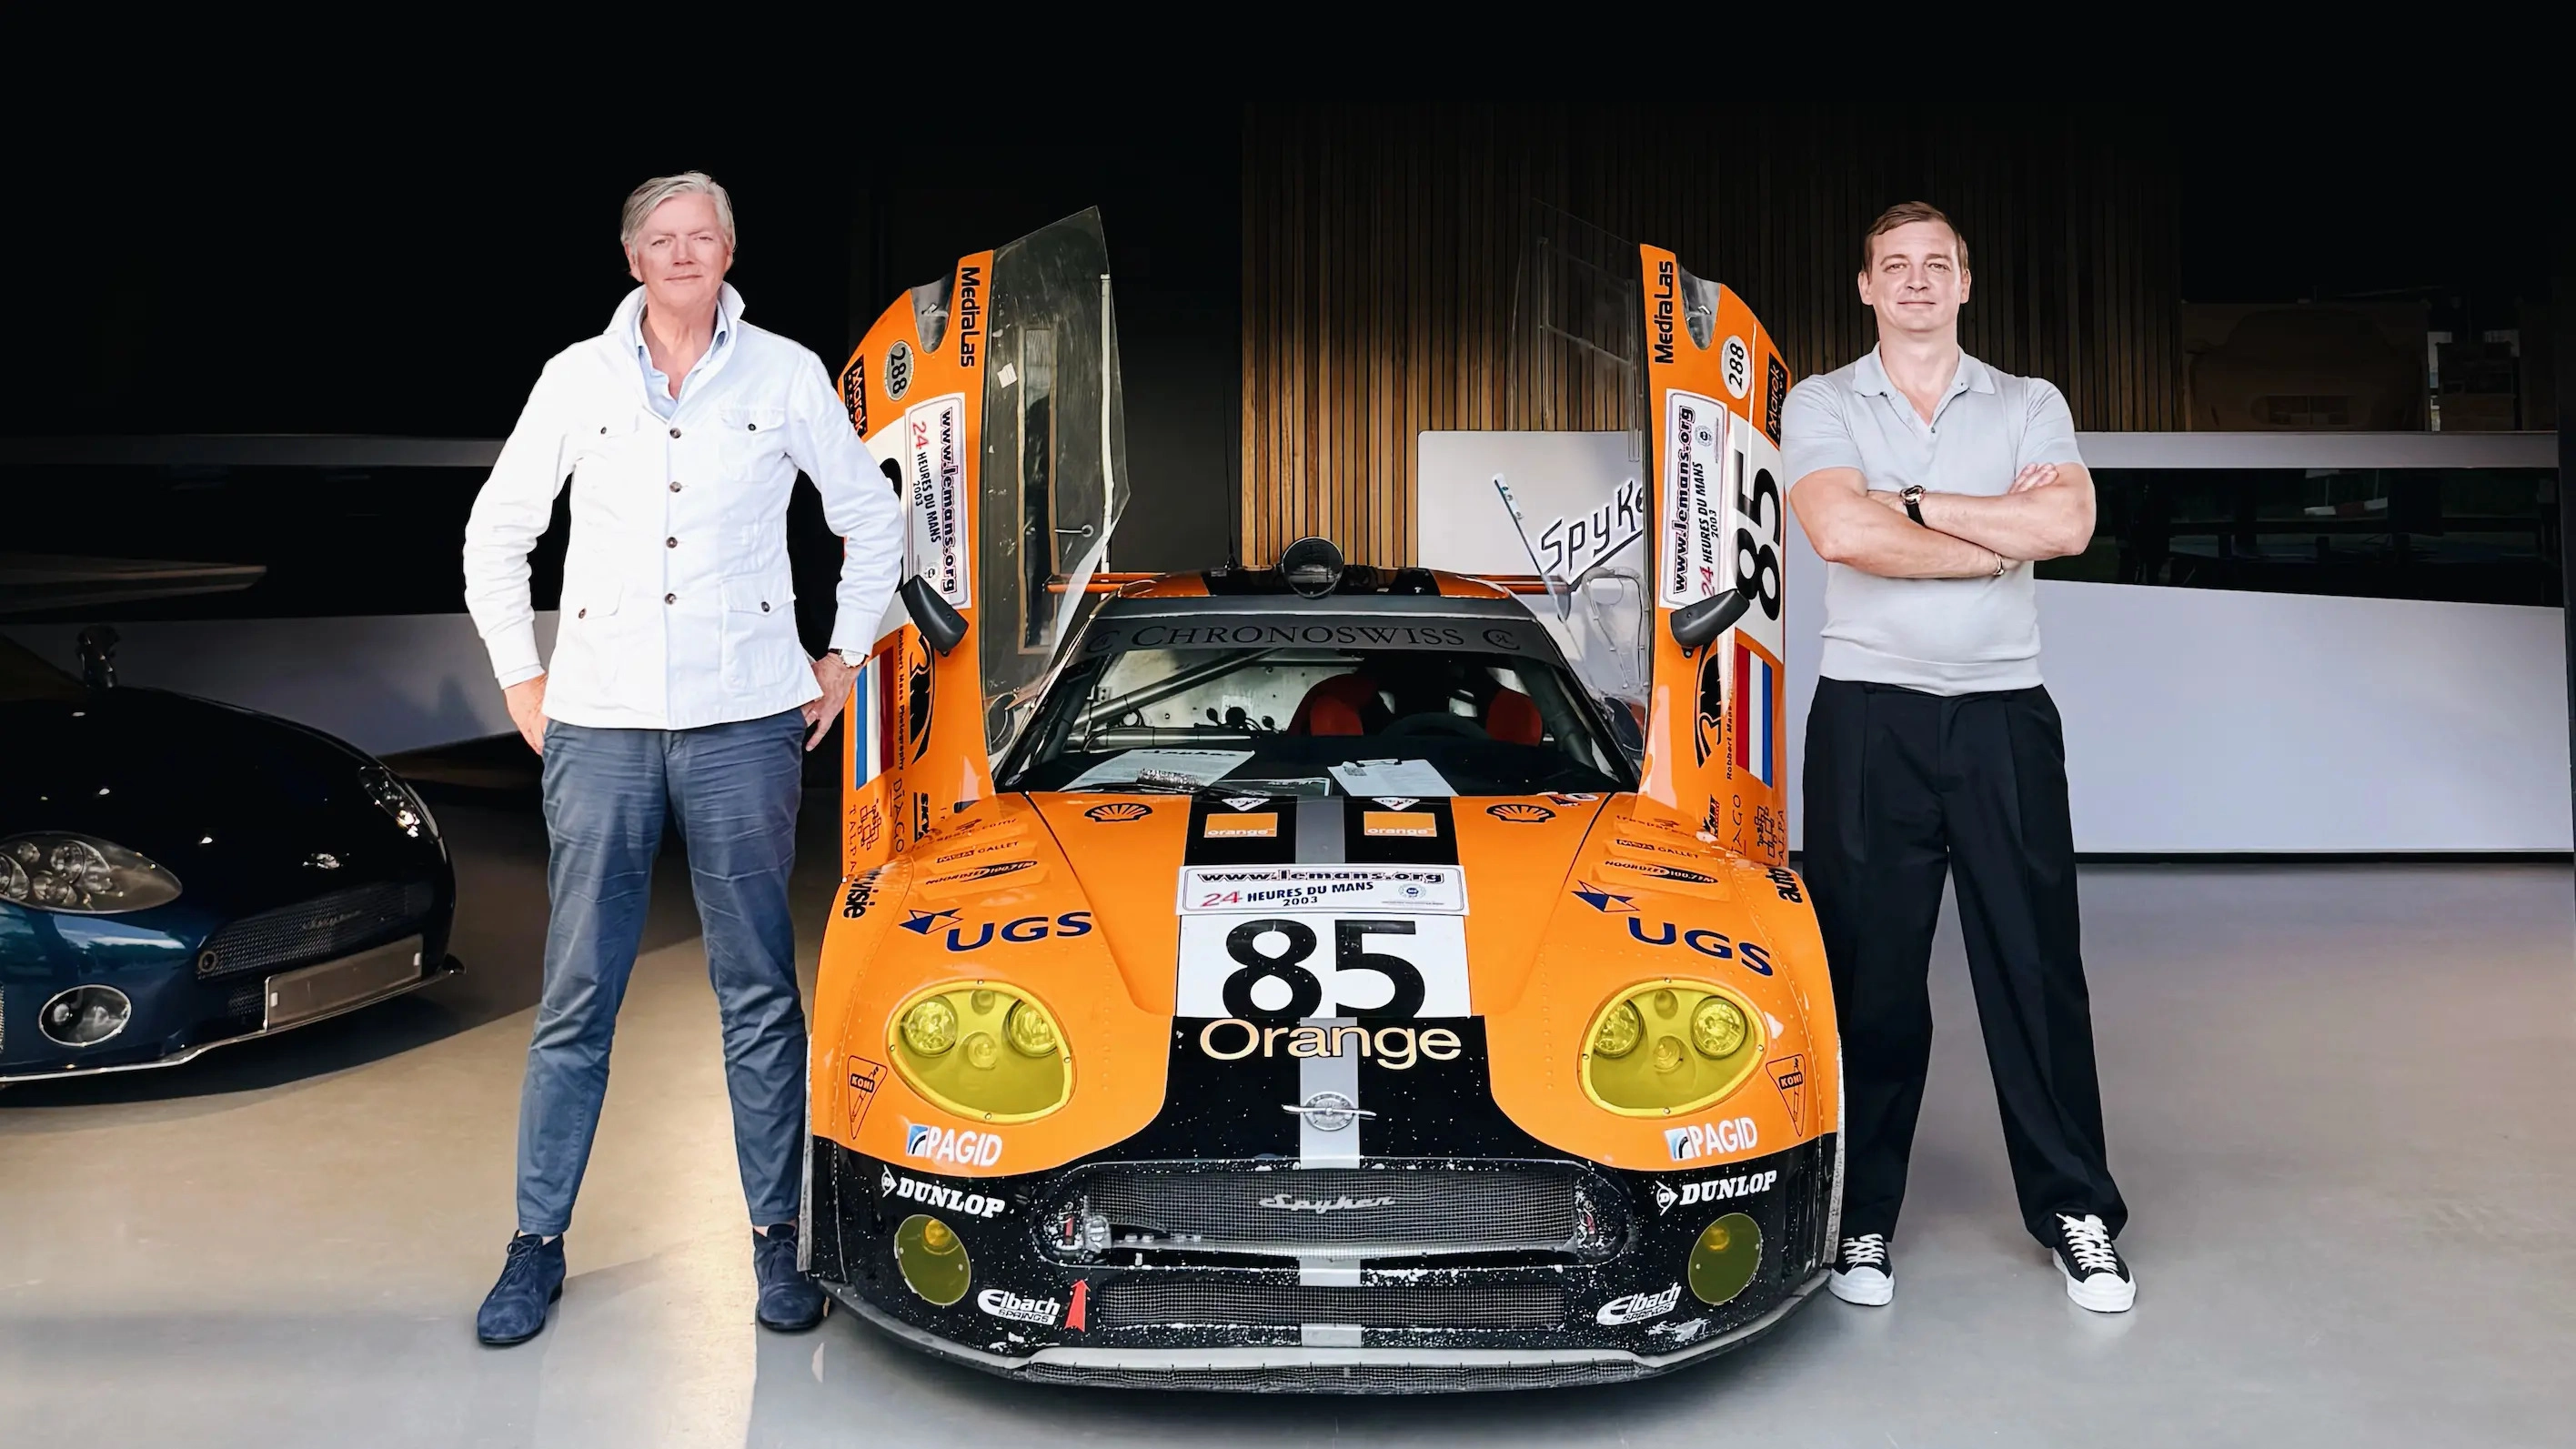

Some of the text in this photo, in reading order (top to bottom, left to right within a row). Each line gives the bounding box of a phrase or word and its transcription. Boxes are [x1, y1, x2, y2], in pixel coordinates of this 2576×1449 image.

[961, 267, 981, 367] MediaLas
[1654, 261, 1674, 364] MediaLas
[888, 347, 906, 394] 288
[1729, 343, 1744, 389] 288
[852, 366, 867, 433] Marek
[1768, 365, 1781, 435] Marek
[912, 421, 941, 543] 24 HEURES DU MANS
[913, 480, 923, 507] 2003
[941, 407, 958, 594] www.lemans.org
[1672, 406, 1695, 594] www.lemans.org
[1692, 461, 1715, 598] 24 HEURES DU MANS
[1709, 509, 1718, 538] 2003
[1734, 448, 1781, 621] 85
[1132, 625, 1465, 649] CHRONOSWISS
[1208, 828, 1270, 838] orange
[1367, 827, 1429, 837] orange
[1197, 869, 1445, 884] www.lemans.org
[1200, 881, 1374, 908] 24 HEURES DU MANS
[1283, 896, 1318, 907] 2003
[946, 911, 1092, 952] UGS
[1628, 916, 1774, 977] UGS
[1222, 919, 1426, 1019] 85
[1199, 1018, 1463, 1071] Orange
[851, 1075, 873, 1091] KONI
[1780, 1073, 1803, 1088] KONI
[926, 1125, 1003, 1167] PAGID
[1688, 1117, 1758, 1158] PAGID
[896, 1177, 1005, 1218] DUNLOP
[1259, 1192, 1396, 1214] Spyker
[1679, 1170, 1777, 1206] DUNLOP
[977, 1288, 1061, 1317] Eibach
[1596, 1282, 1682, 1319] Eibach
